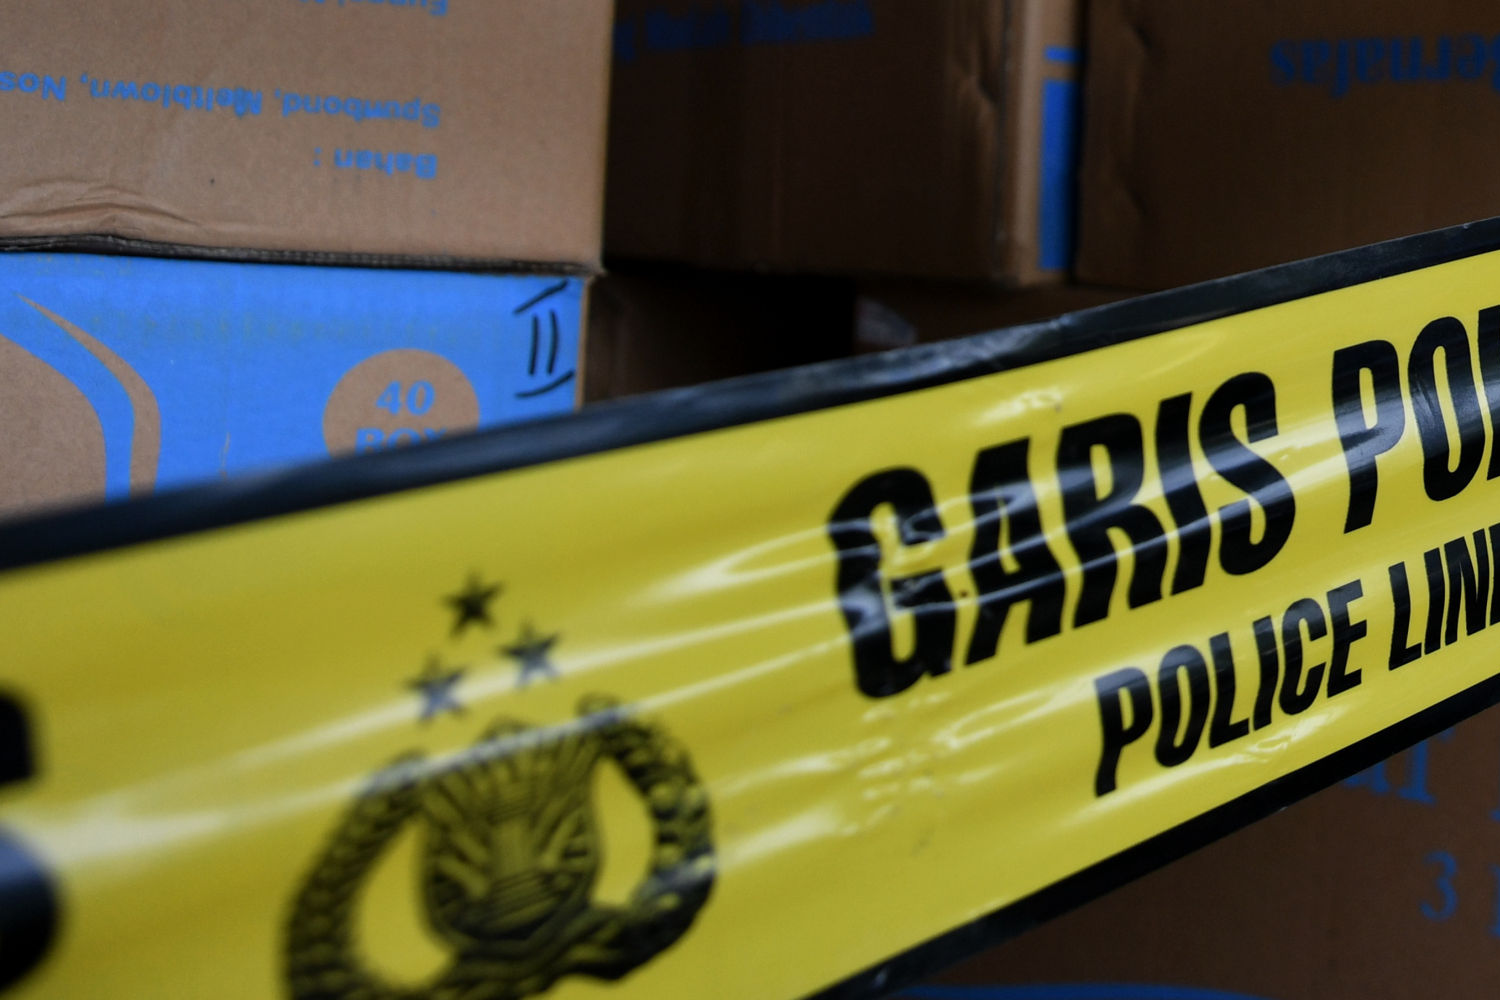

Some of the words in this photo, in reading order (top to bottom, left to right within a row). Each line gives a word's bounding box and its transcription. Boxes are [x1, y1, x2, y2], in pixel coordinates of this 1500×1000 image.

[80, 71, 263, 118] Meltblown,
[333, 147, 438, 179] Bahan
[375, 379, 437, 417] 40
[826, 371, 1297, 699] GARIS
[1094, 579, 1369, 798] POLICE
[1418, 849, 1459, 923] 3
